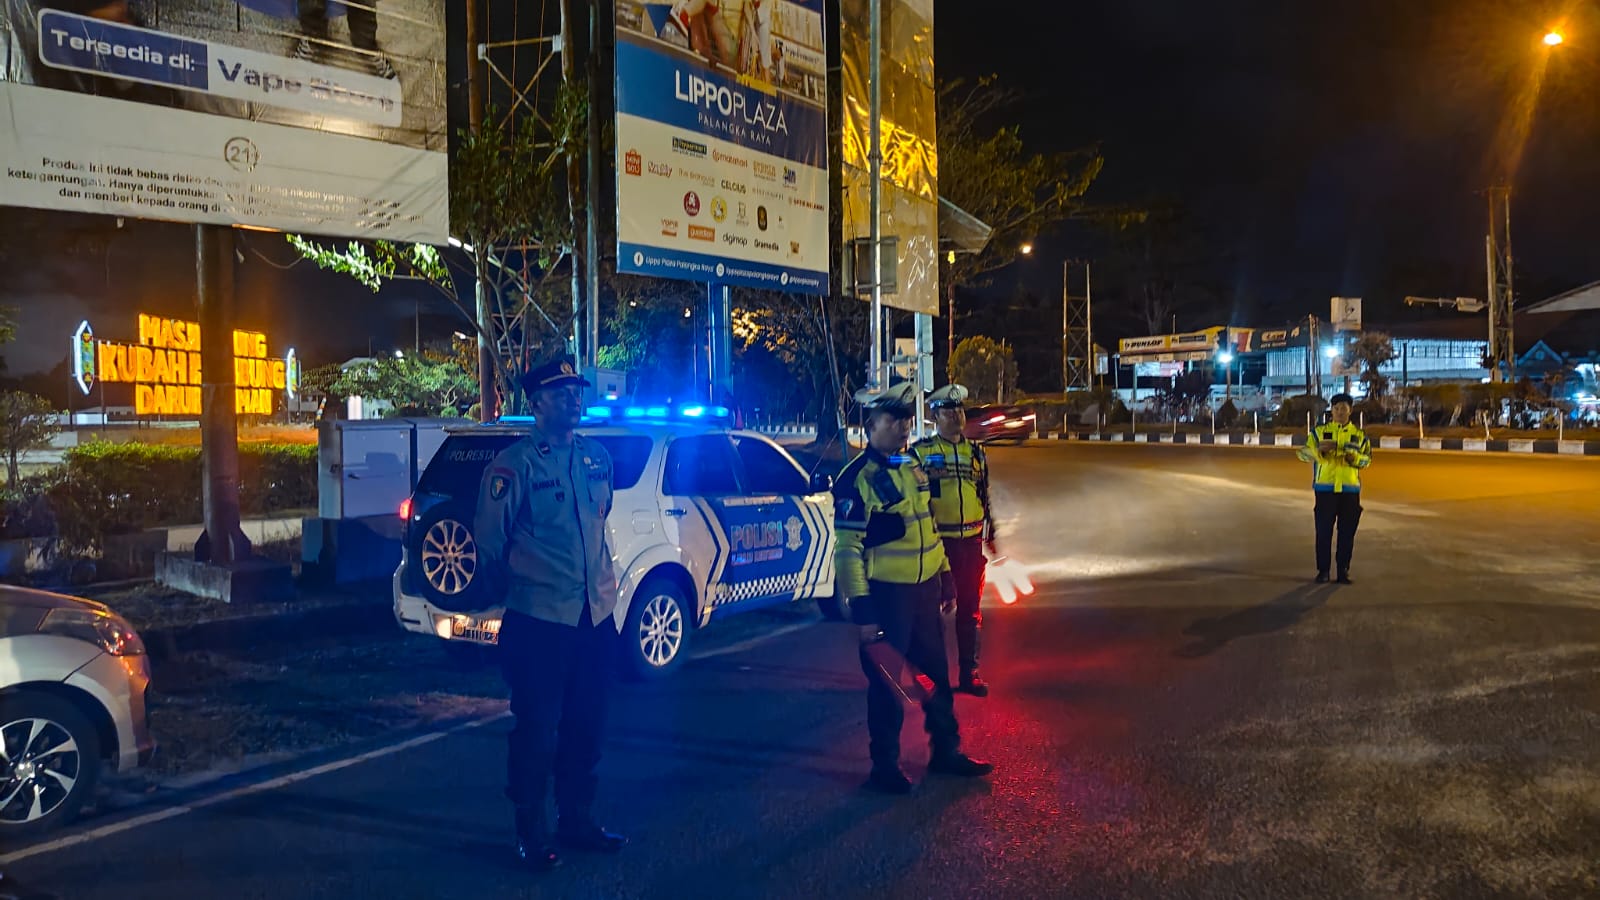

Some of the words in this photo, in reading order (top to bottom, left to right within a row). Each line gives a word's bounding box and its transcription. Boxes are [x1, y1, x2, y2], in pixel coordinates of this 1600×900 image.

[51, 28, 164, 66] Tersedia
[168, 53, 196, 71] di:
[218, 59, 302, 92] Vape
[698, 114, 746, 137] PALANGKA
[750, 129, 771, 146] RAYA
[89, 162, 103, 174] ini
[107, 165, 133, 178] tidak
[137, 168, 169, 181] bebas
[109, 179, 143, 193] Hanya
[59, 187, 81, 199] dan
[84, 190, 134, 204] memberi
[137, 194, 175, 209] kepada
[178, 200, 209, 213] orang
[211, 202, 221, 212] di
[722, 233, 748, 247] digimap
[1131, 339, 1163, 348] DUNLOP
[98, 340, 188, 384] KUBAH
[731, 520, 783, 552] POLISI
